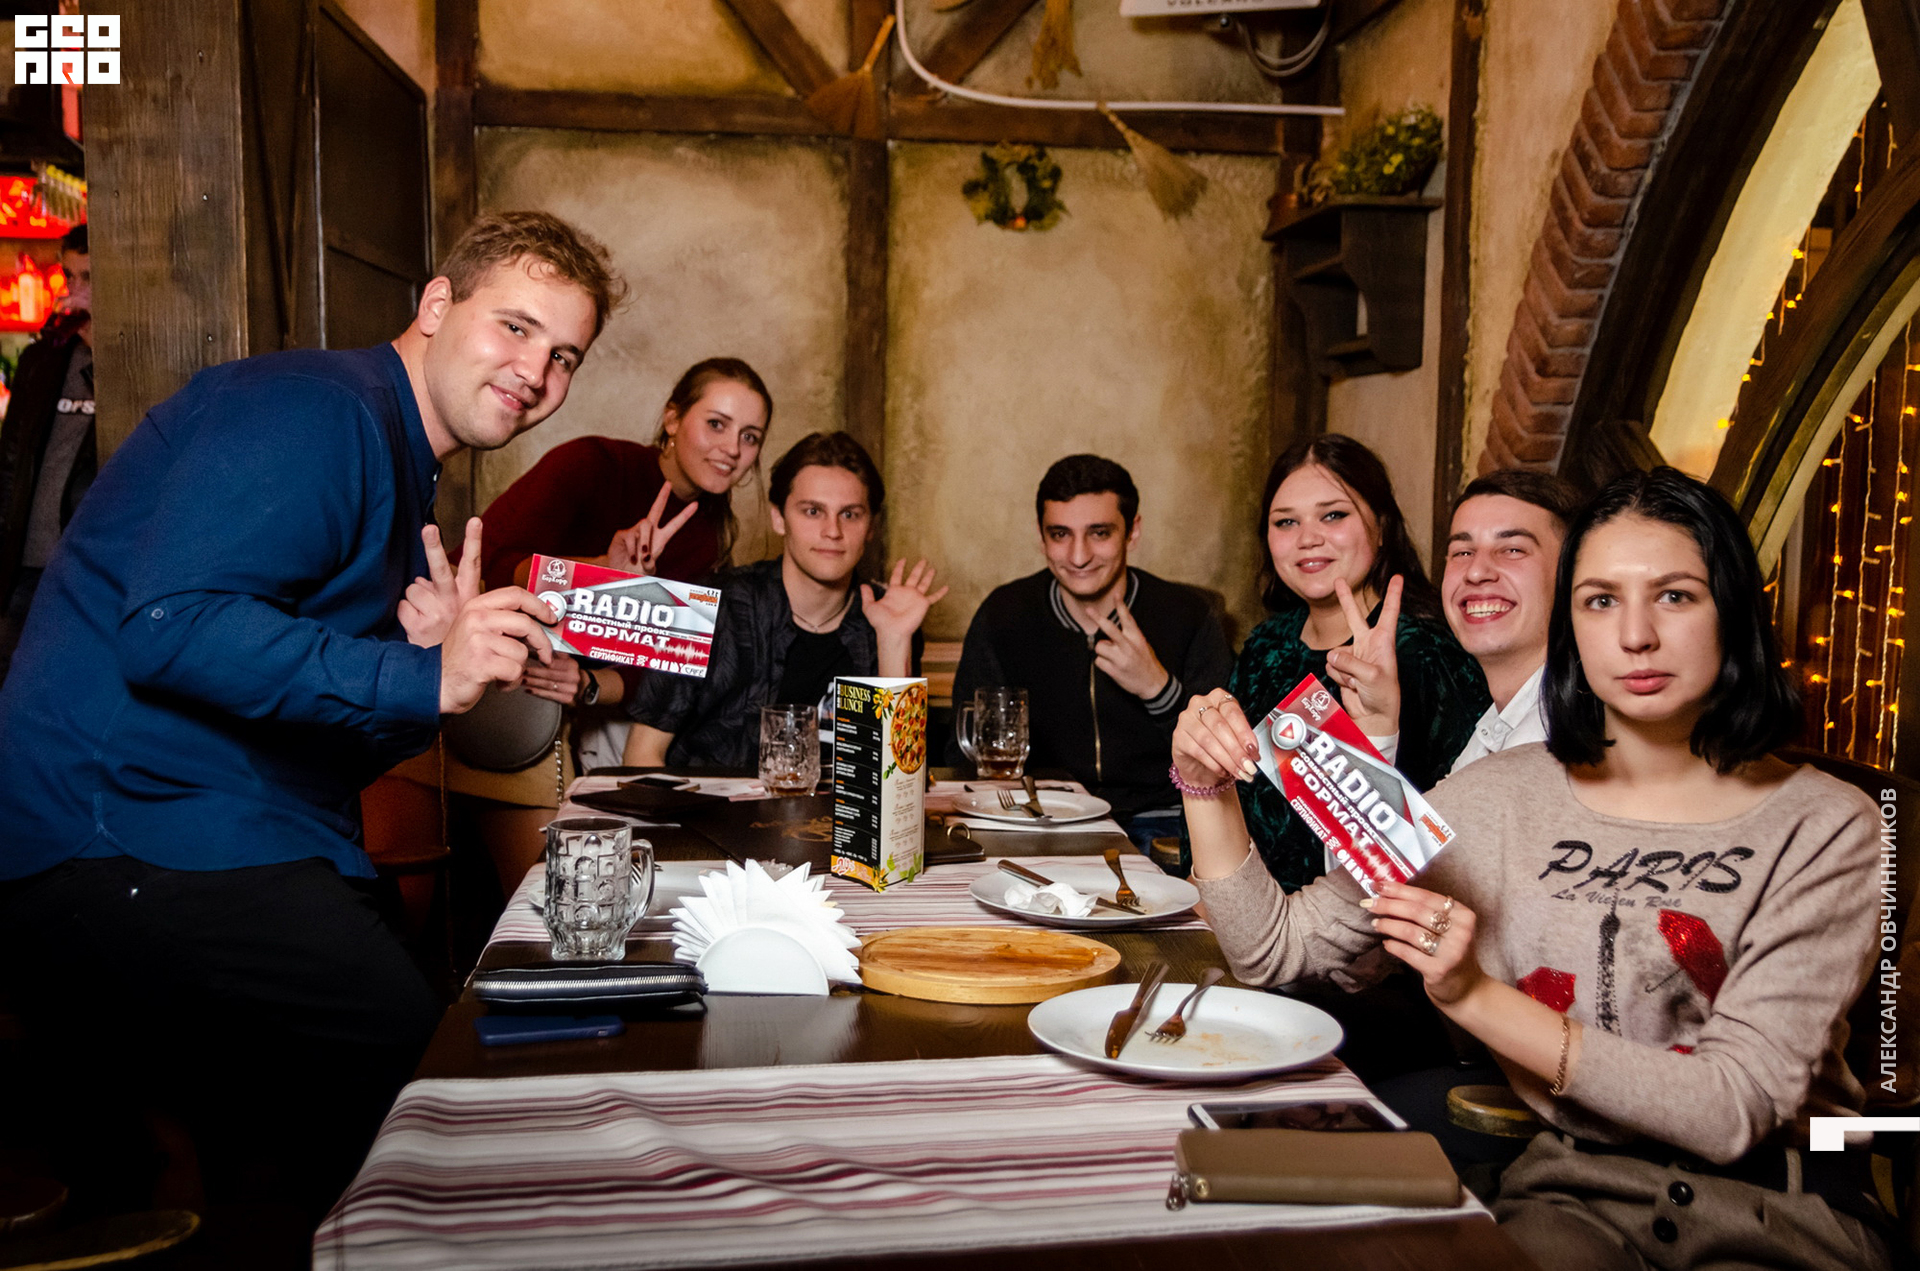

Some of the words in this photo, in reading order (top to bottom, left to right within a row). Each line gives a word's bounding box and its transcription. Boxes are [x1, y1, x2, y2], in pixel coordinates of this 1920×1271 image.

[572, 588, 675, 628] RADIO
[568, 620, 671, 649] ФОРМАТ
[589, 651, 635, 665] СЕРТИФИКАТ
[840, 684, 871, 702] BUSINESS
[840, 697, 863, 713] LUNCH
[1300, 751, 1349, 807] совместный
[1347, 805, 1377, 839] проект
[1307, 731, 1397, 831] RADIO
[1290, 756, 1374, 848] ФОРМАТ
[1290, 798, 1328, 840] СЕРТИФИКАТ
[1538, 840, 1755, 894] PARIS
[1551, 888, 1577, 901] La
[1644, 895, 1682, 909] Rose
